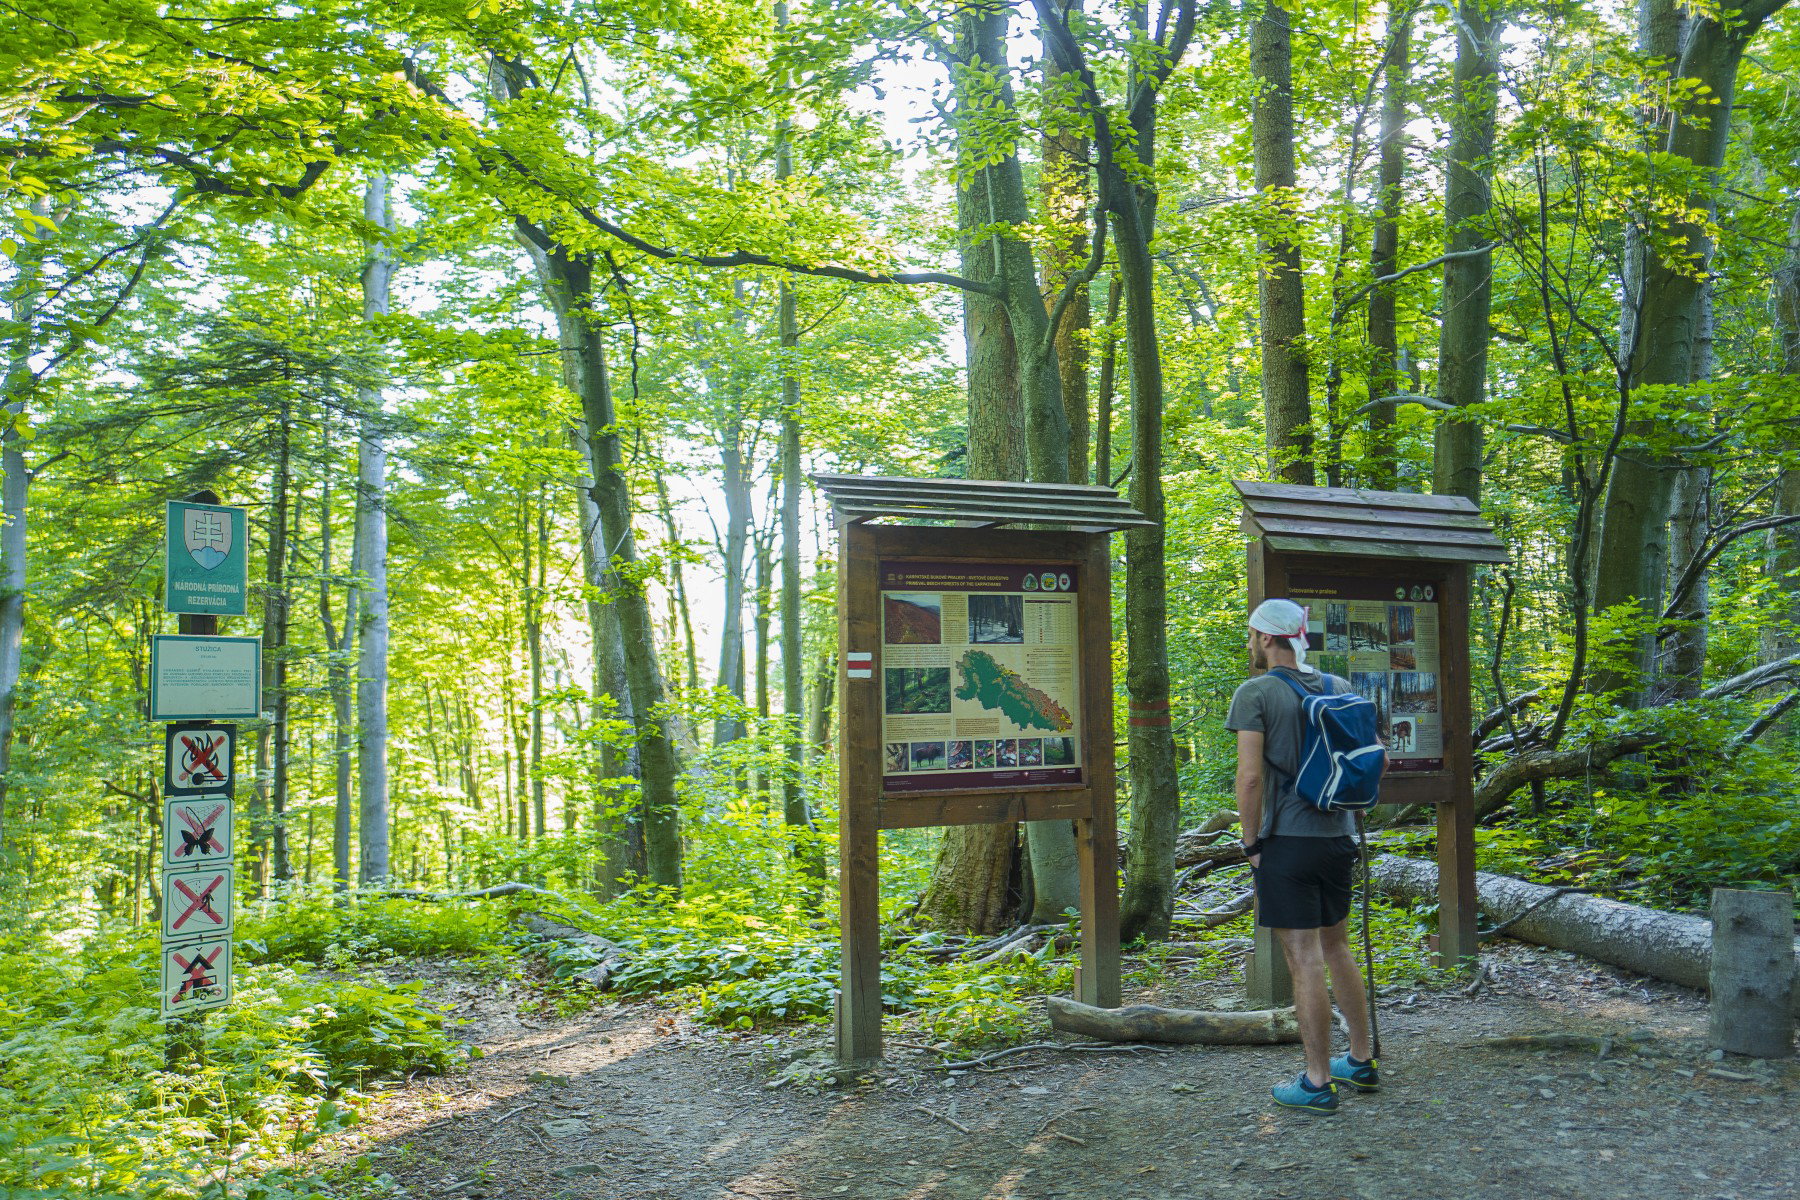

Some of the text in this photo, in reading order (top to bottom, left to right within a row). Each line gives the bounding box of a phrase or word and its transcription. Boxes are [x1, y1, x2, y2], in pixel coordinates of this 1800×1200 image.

[175, 580, 240, 594] NÁRODNÁ PRÍRODNÁ
[187, 595, 227, 606] REZERVÁCIA
